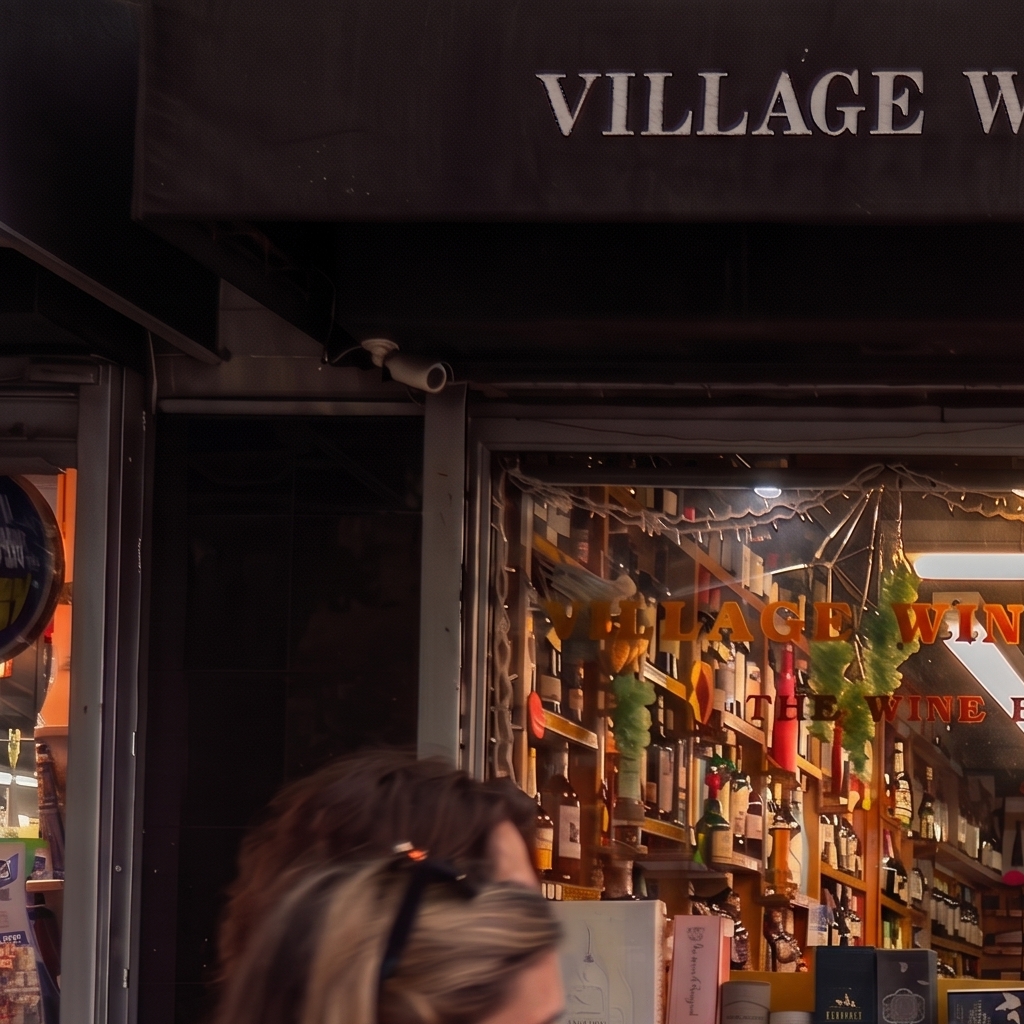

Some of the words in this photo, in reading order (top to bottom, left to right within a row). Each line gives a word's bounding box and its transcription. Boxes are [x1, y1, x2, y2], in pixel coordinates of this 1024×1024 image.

[535, 69, 924, 137] VILLAGE
[544, 600, 853, 643] VILLAGE
[746, 695, 842, 721] THE
[864, 695, 988, 725] WINE
